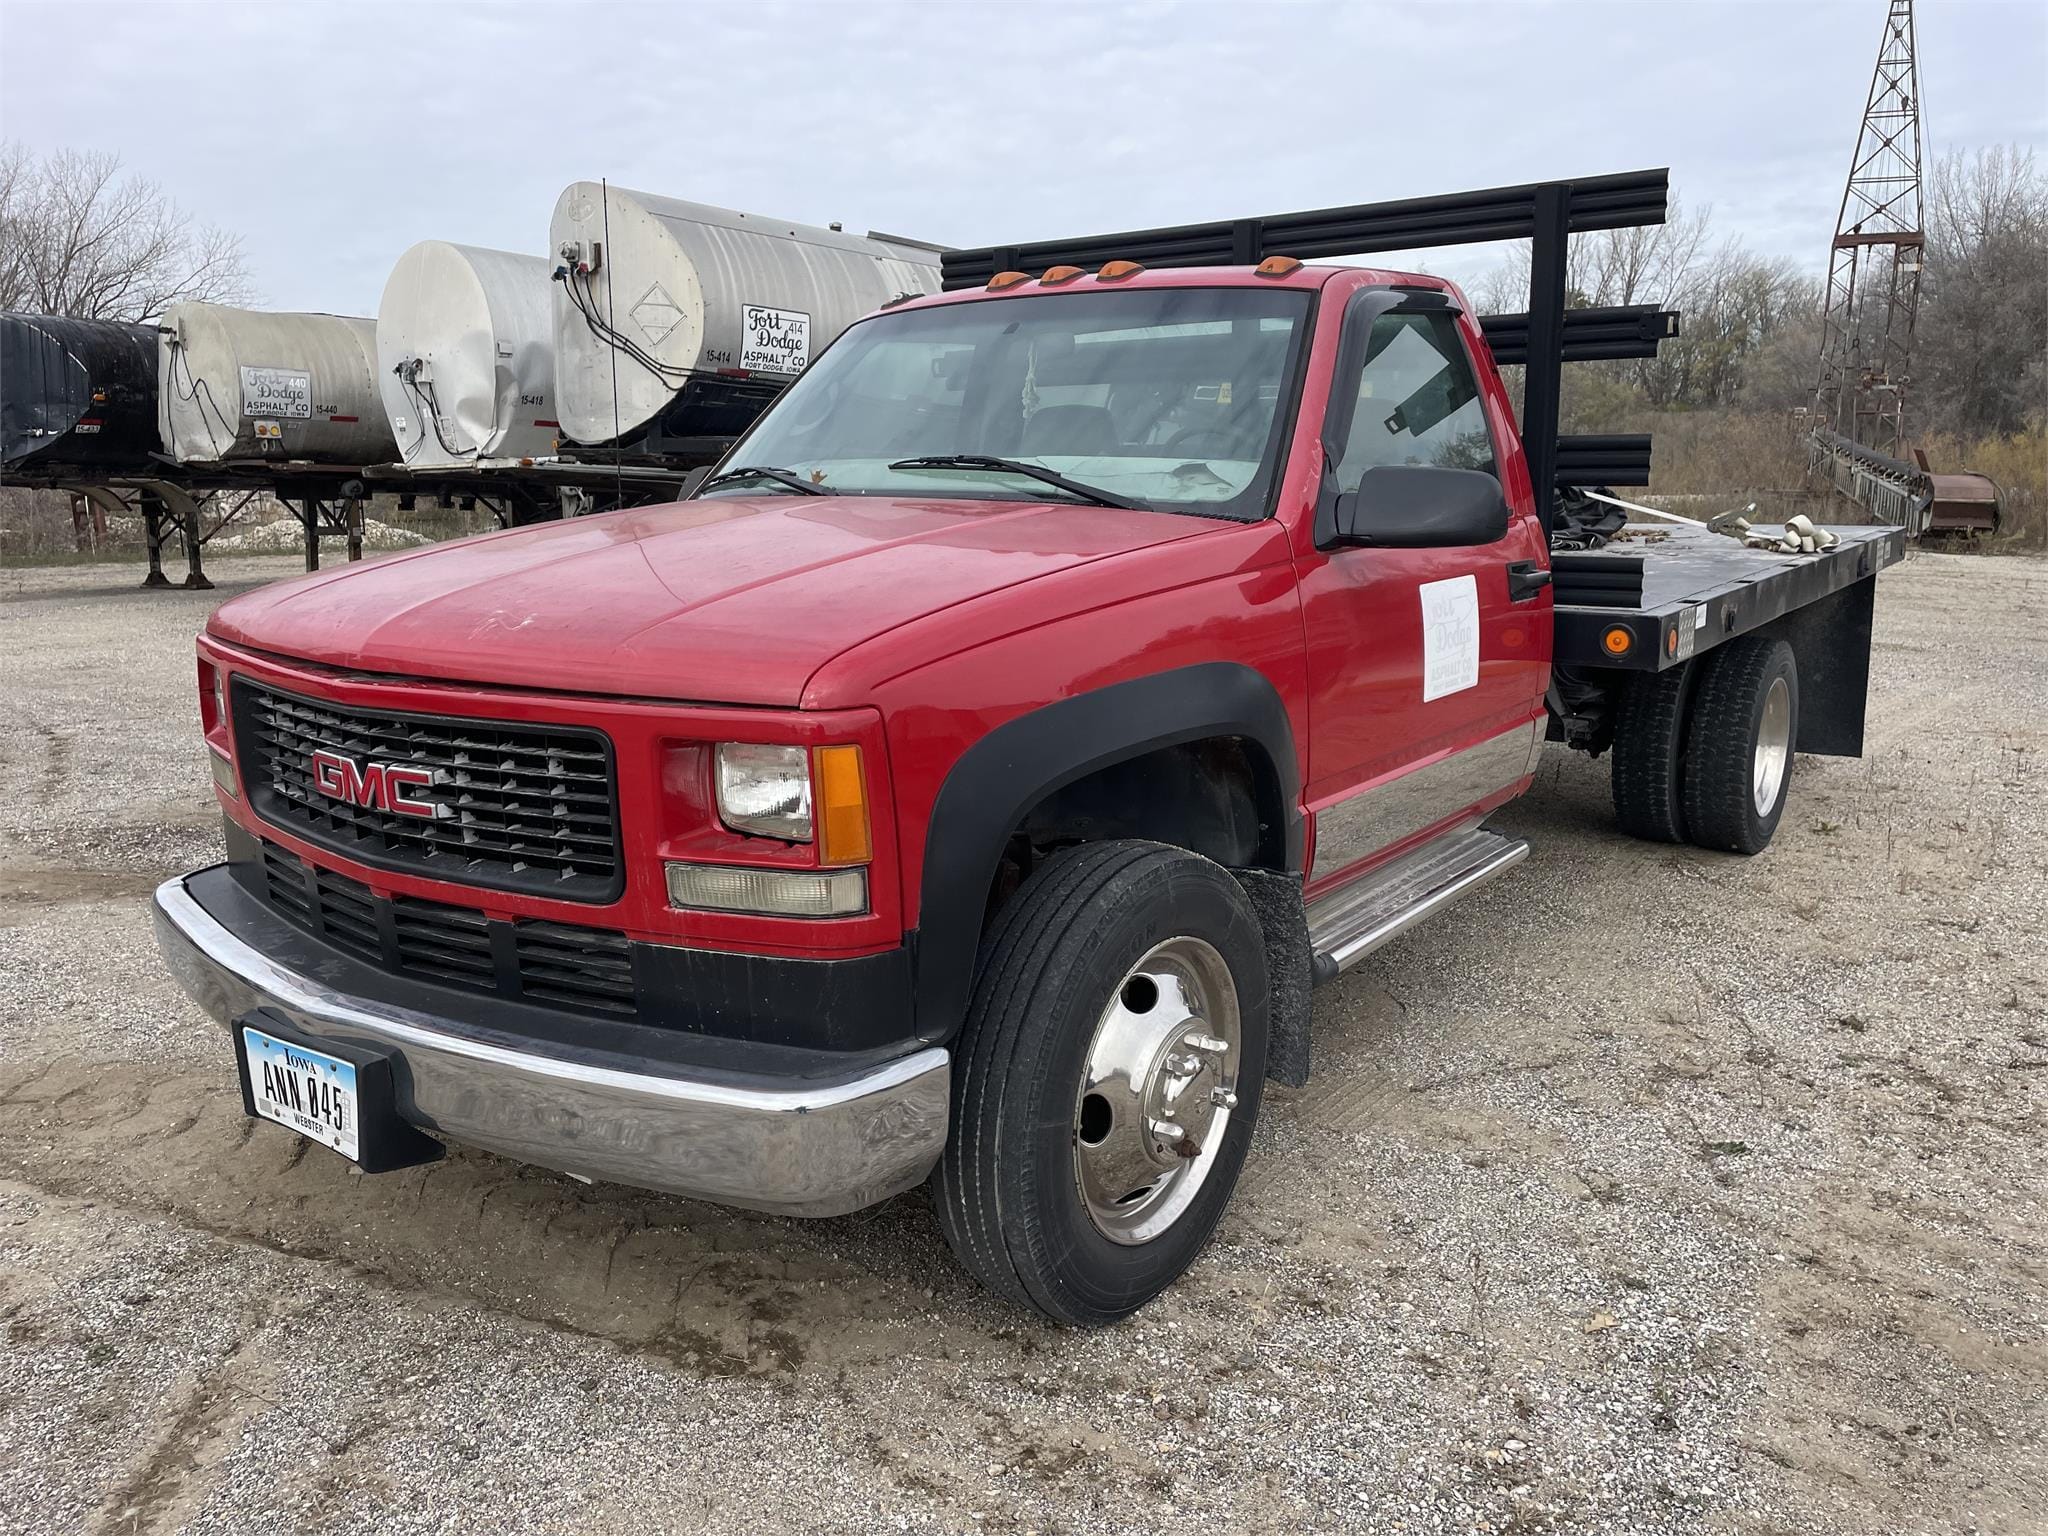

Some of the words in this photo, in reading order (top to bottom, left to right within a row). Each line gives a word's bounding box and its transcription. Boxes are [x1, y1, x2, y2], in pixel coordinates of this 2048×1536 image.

[748, 307, 782, 331] Fort
[788, 322, 803, 336] 414
[755, 328, 803, 358] Dodge
[706, 349, 731, 364] 15-414
[743, 350, 787, 365] ASPHALT
[792, 356, 805, 367] CO
[745, 362, 762, 370] FORT
[786, 366, 801, 374] IOWA
[288, 378, 306, 389] 440
[257, 383, 305, 406] Dodge
[521, 394, 544, 406] 15-418
[246, 401, 290, 412] ASPHALT
[295, 402, 309, 413] CO
[315, 404, 338, 415] 15-440
[312, 749, 438, 820] GMC
[263, 1060, 302, 1113] ANN
[307, 1076, 343, 1131] 045
[293, 1112, 324, 1136] WEBSTER
